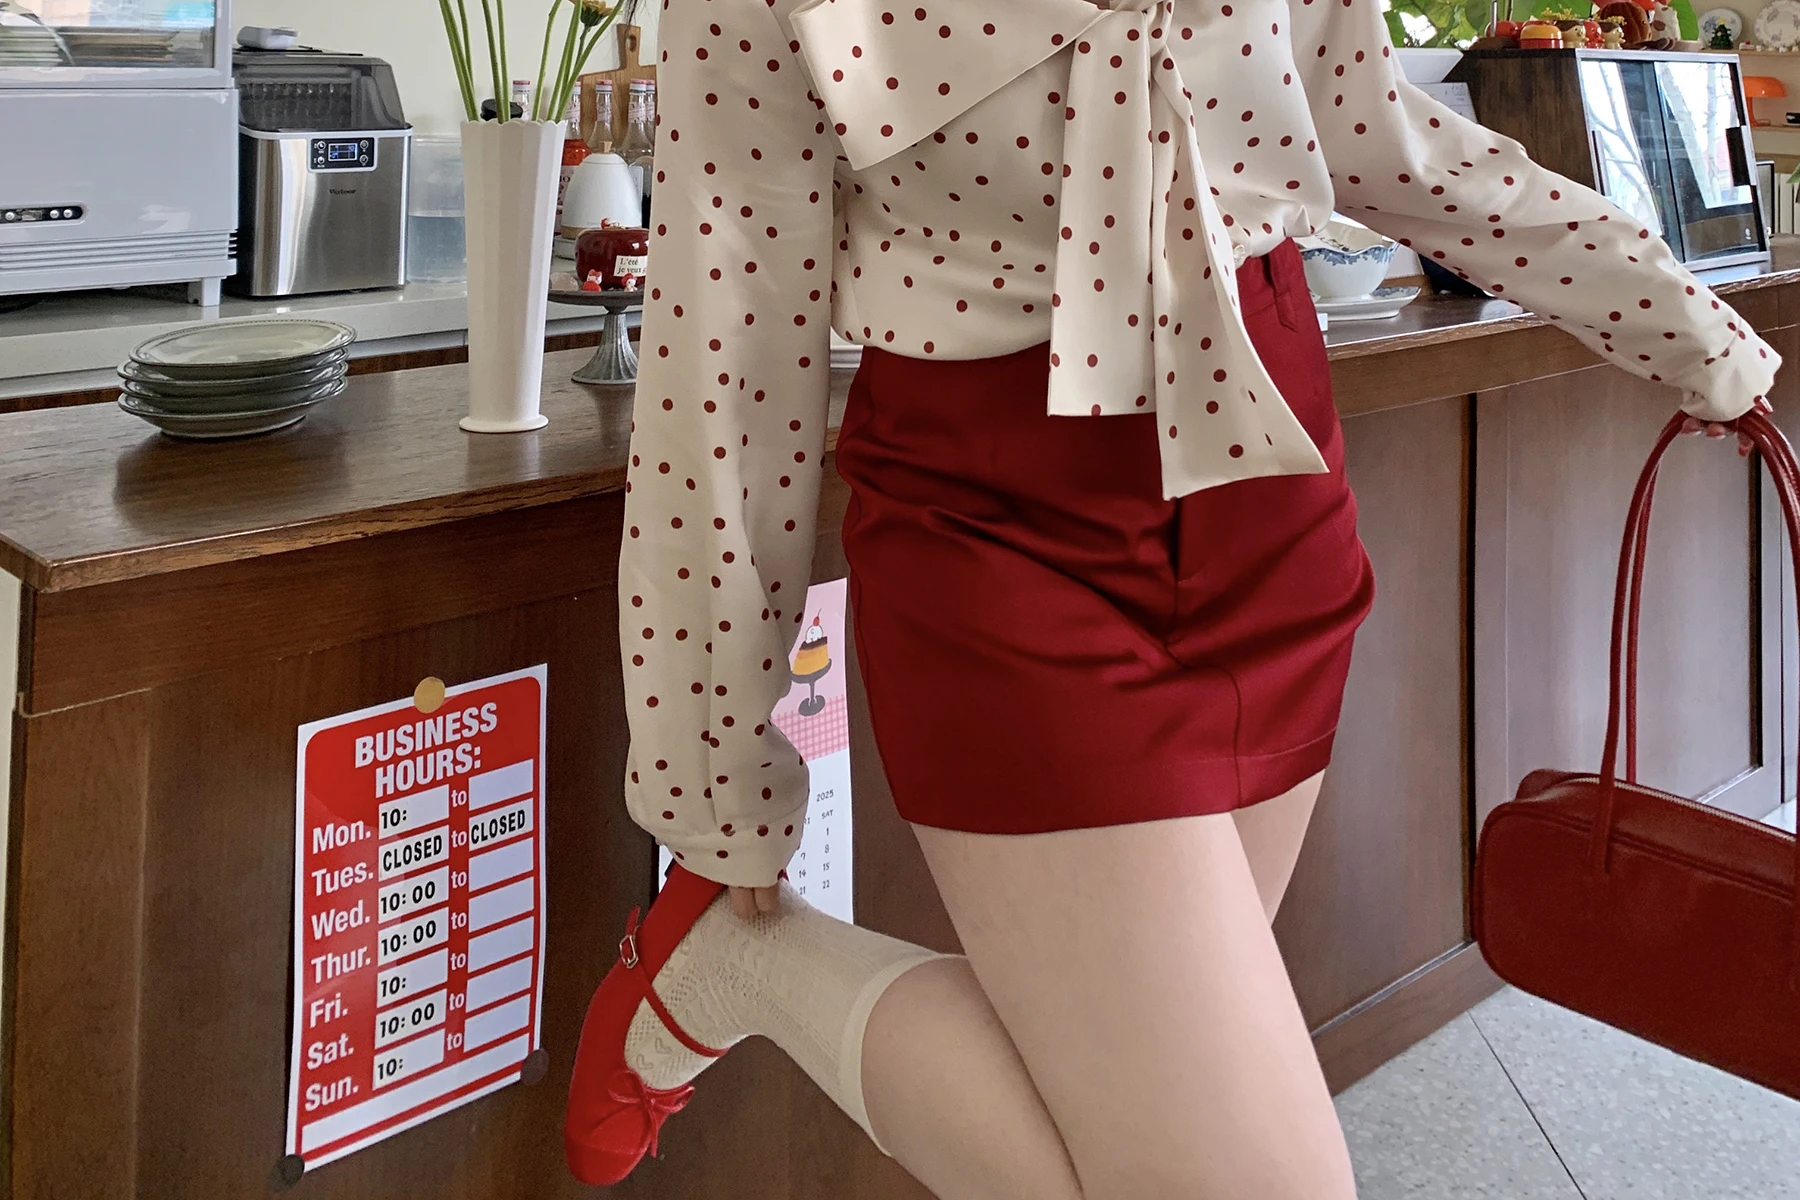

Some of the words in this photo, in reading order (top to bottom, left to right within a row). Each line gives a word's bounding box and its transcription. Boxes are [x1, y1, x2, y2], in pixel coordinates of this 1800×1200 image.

[355, 702, 498, 768] BUSINESS
[375, 743, 481, 798] HOURS:
[816, 789, 835, 802] 2025
[312, 820, 371, 854] Mon.
[381, 808, 407, 829] 10:
[451, 789, 467, 807] to
[821, 809, 834, 819] SAT
[311, 862, 374, 896] Tues.
[383, 835, 442, 872] CLOSED
[451, 829, 467, 848] to
[471, 809, 526, 844] CLOSED
[798, 869, 807, 878] 14
[822, 863, 830, 871] 15
[824, 844, 830, 854] 8
[311, 899, 370, 940] Wed.
[451, 870, 467, 888] to
[822, 880, 830, 889] 22
[311, 946, 371, 984] Thur.
[451, 911, 467, 930] to
[309, 992, 348, 1029] Fri.
[380, 976, 406, 997] 10:
[450, 952, 466, 970] to
[306, 1032, 354, 1070] Sat.
[449, 993, 465, 1011] to
[304, 1075, 359, 1112] Sun.
[377, 1058, 403, 1080] 10:
[446, 1032, 462, 1051] to
